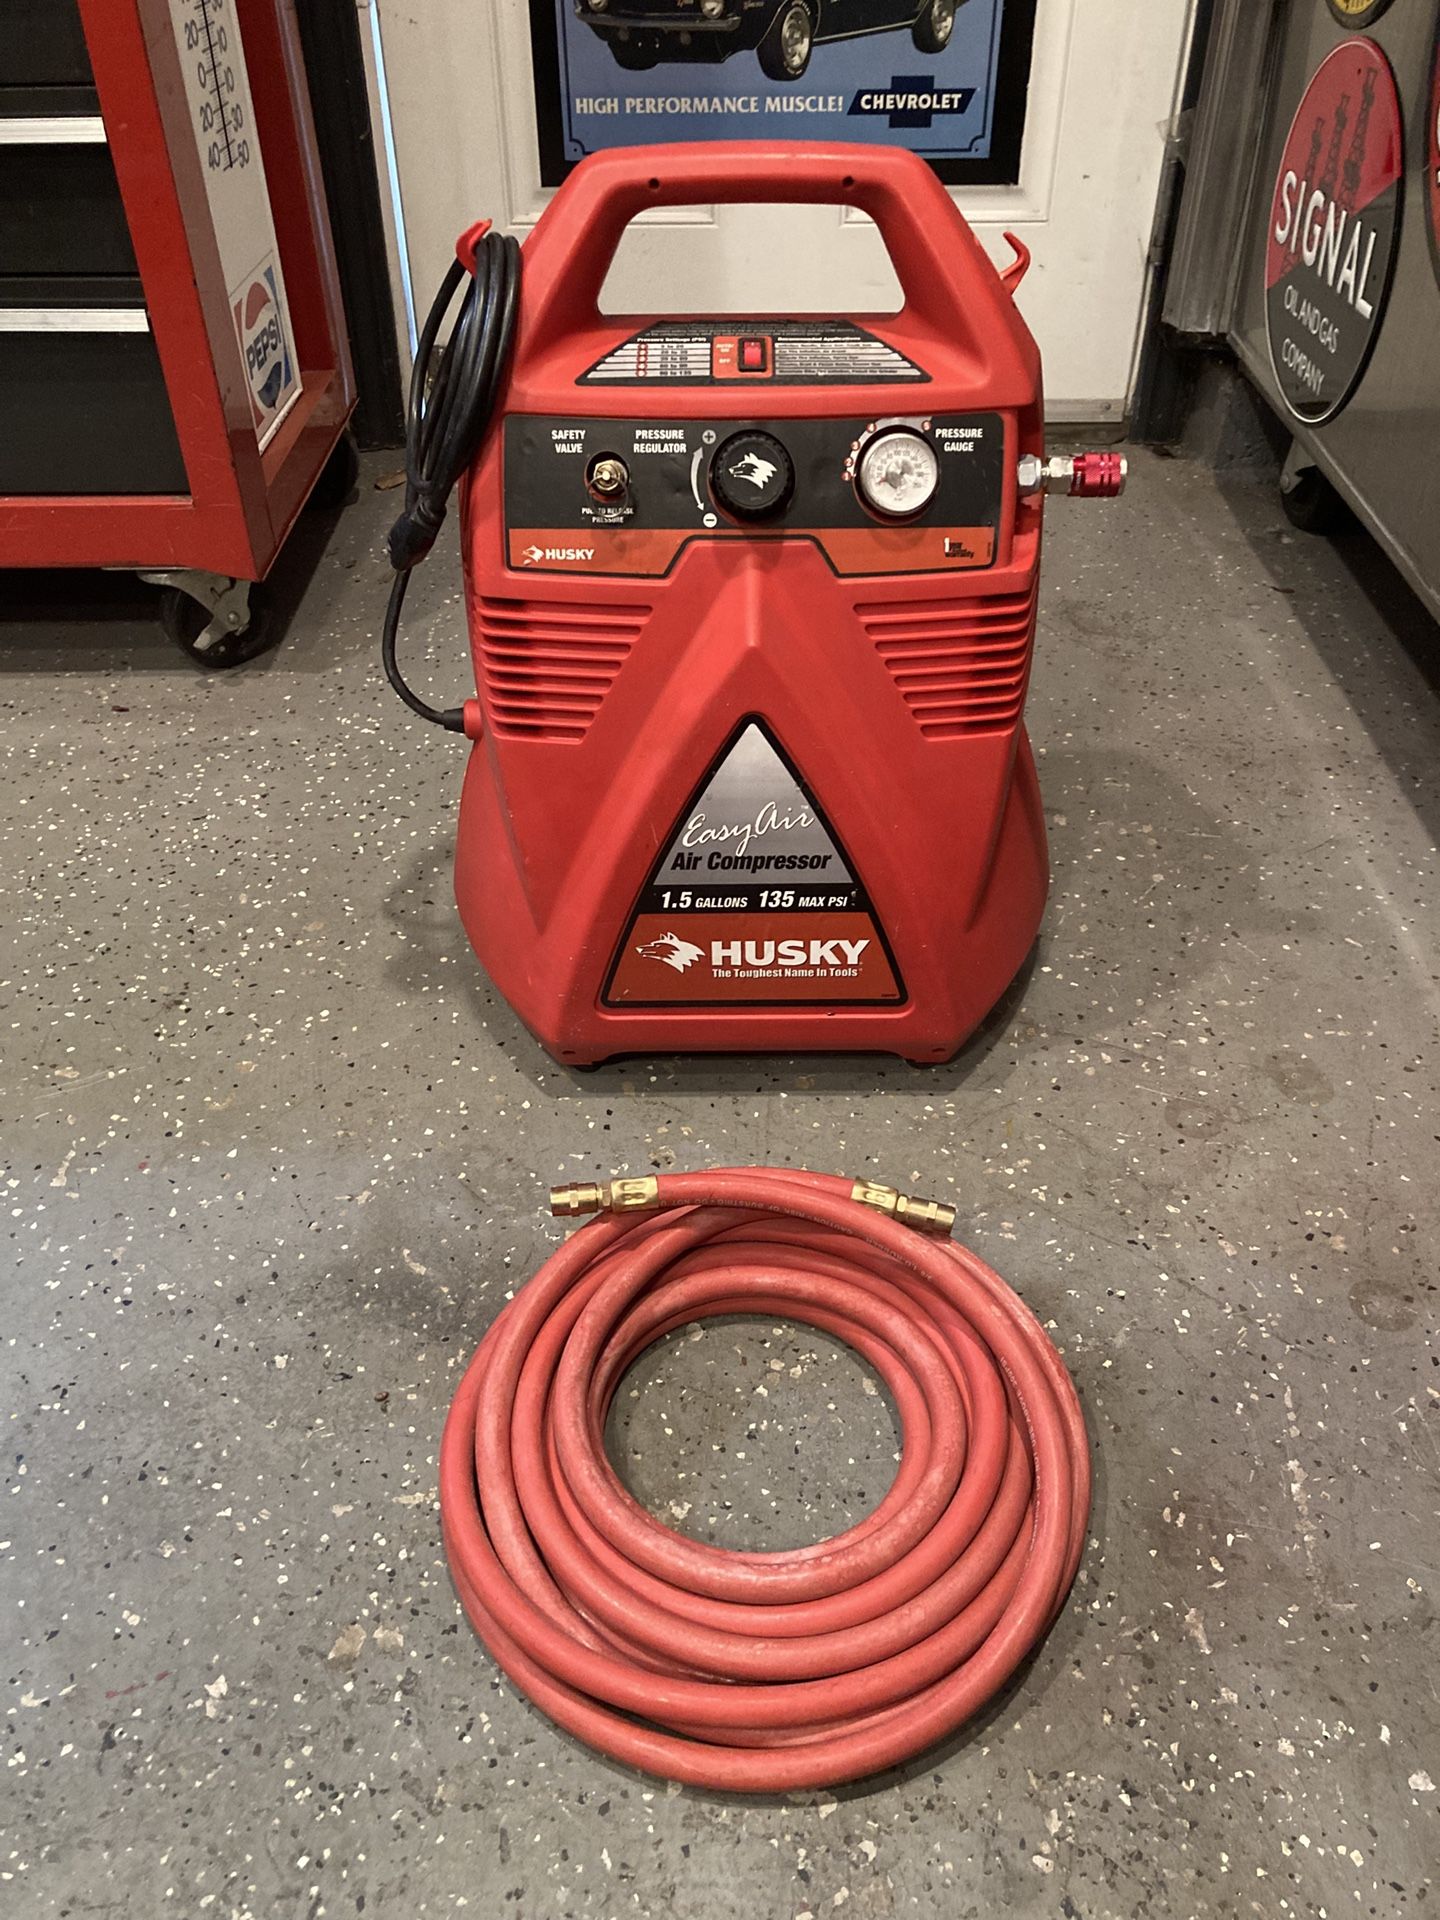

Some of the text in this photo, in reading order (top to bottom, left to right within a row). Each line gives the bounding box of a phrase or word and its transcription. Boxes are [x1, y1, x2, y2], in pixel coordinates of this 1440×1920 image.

[184, 19, 199, 50] 20
[197, 62, 207, 89] 0
[575, 95, 843, 114] HIGH PERFORMANCE MUSCLE!
[860, 93, 962, 110] CHEVROLET
[200, 102, 214, 133] 20
[208, 141, 221, 171] 40
[1275, 170, 1377, 320] SIGNAL
[1284, 284, 1340, 354] OIL AND GAS
[246, 313, 282, 381] PEPSI
[1281, 337, 1325, 396] COMPANY
[551, 430, 586, 440] SAFETY
[635, 430, 684, 440] PRESSURE
[935, 428, 984, 439] PRESSURE
[555, 443, 583, 454] VALVE
[633, 443, 687, 454] REGULATOR
[943, 441, 974, 452] GAUGE
[545, 549, 595, 560] HUSKY
[682, 801, 815, 857] Easy Air
[671, 852, 833, 874] Air Compressor
[662, 890, 848, 909] 1.5 GALLONS 135 MAX PSI
[711, 939, 870, 967] HUSKY
[712, 967, 858, 979] The Toughest Name In Tools
